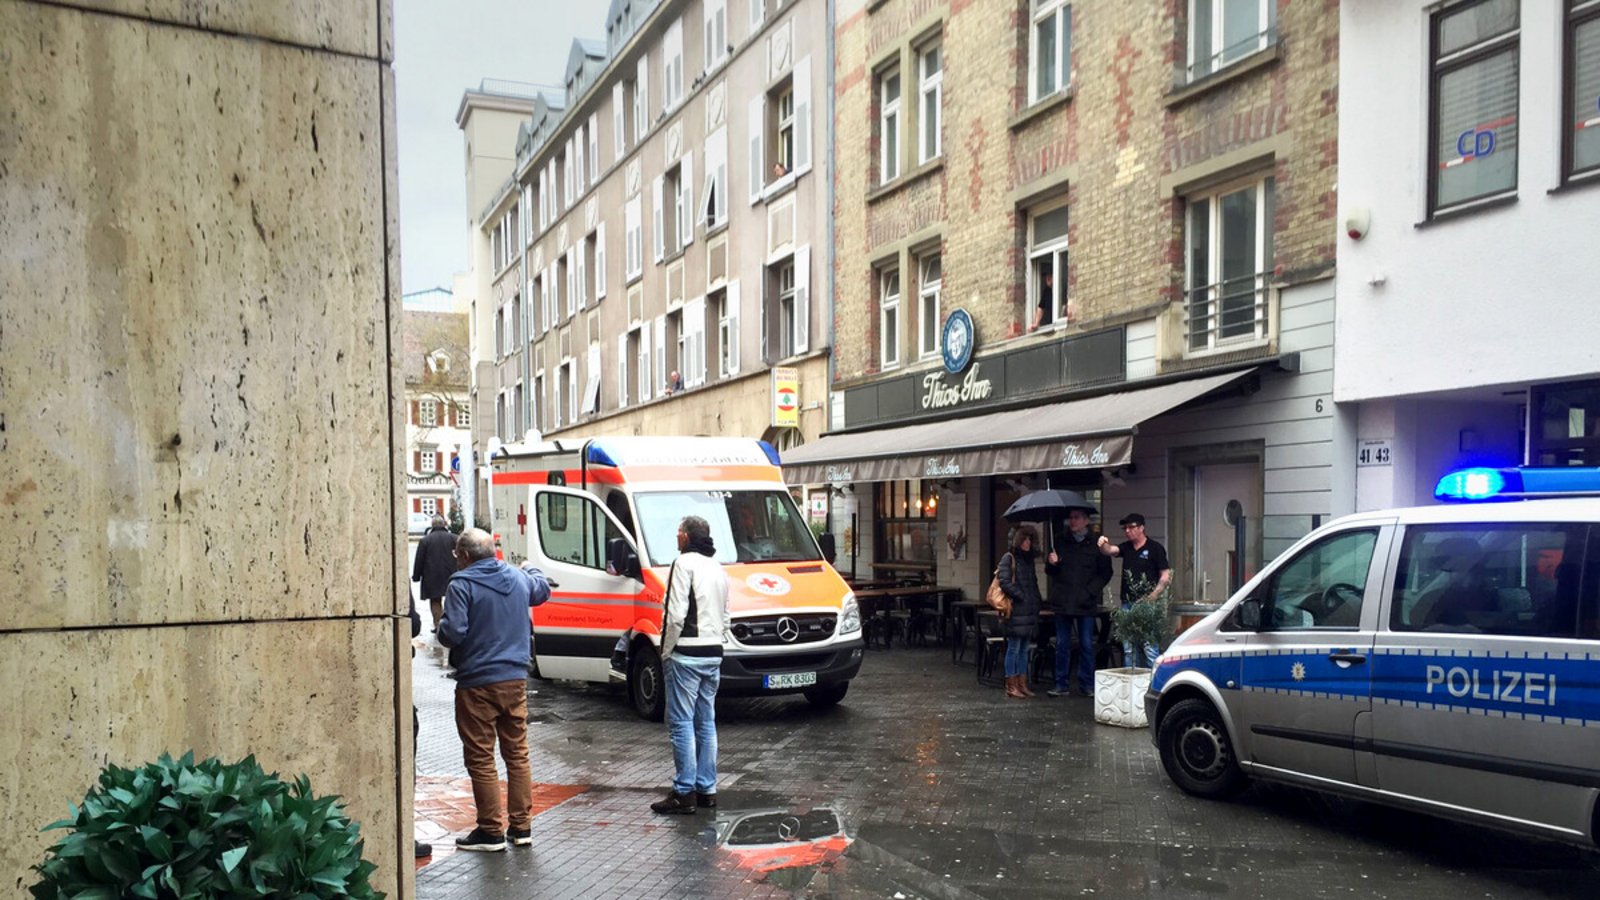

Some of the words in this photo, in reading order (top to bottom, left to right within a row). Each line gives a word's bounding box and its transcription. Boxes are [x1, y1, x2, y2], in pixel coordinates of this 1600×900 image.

[1456, 127, 1496, 158] CD
[961, 362, 993, 402] Inn
[1315, 398, 1324, 413] 6
[1426, 665, 1556, 706] POLIZEI
